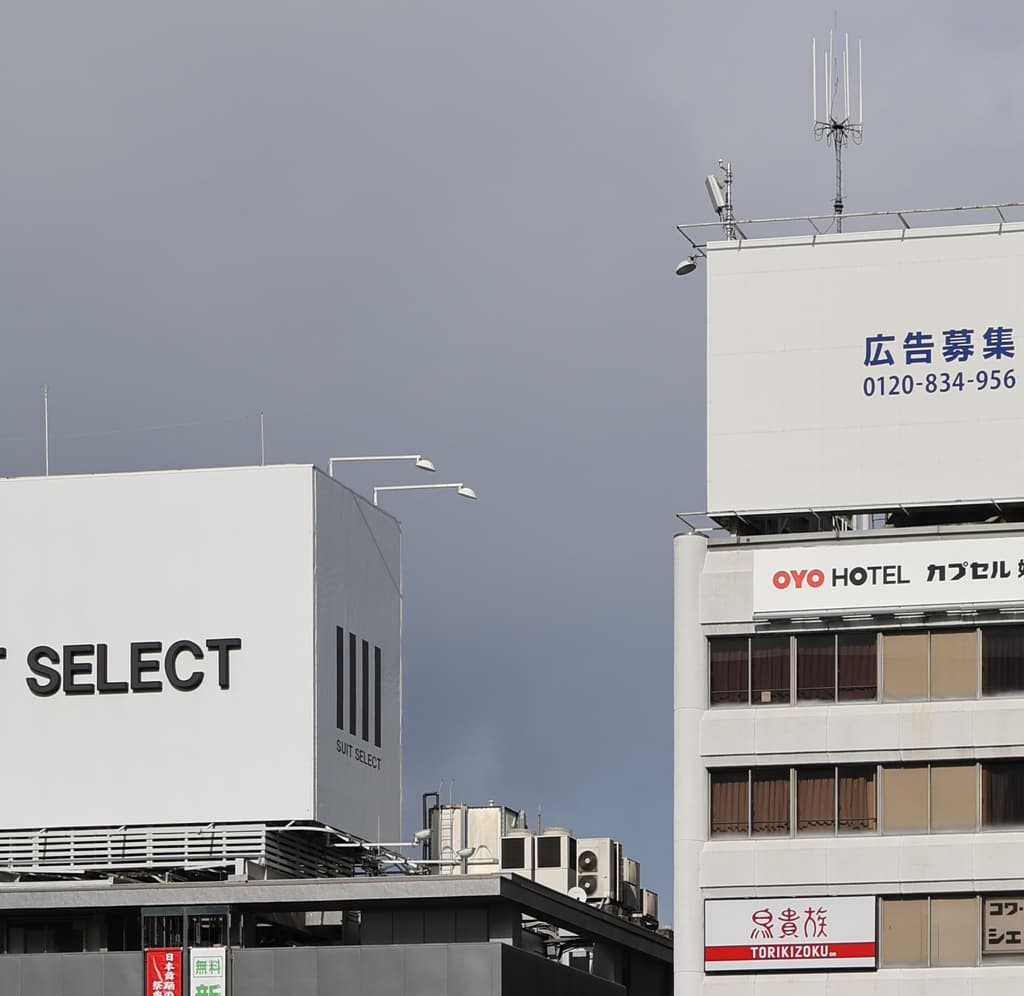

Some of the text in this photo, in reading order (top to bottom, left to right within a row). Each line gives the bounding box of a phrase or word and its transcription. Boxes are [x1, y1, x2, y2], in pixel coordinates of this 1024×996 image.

[863, 327, 1016, 367] 広告募集
[863, 369, 1016, 397] 0120-834-956
[772, 569, 825, 590] OYO
[831, 566, 910, 587] HOTEL
[927, 561, 1010, 583] カプセル
[26, 638, 241, 697] SELECT
[336, 739, 381, 771] SUIT SELECT
[750, 907, 828, 939] 鳥貴族
[195, 959, 221, 975] 無料
[750, 945, 829, 959] TORIKIZOKU
